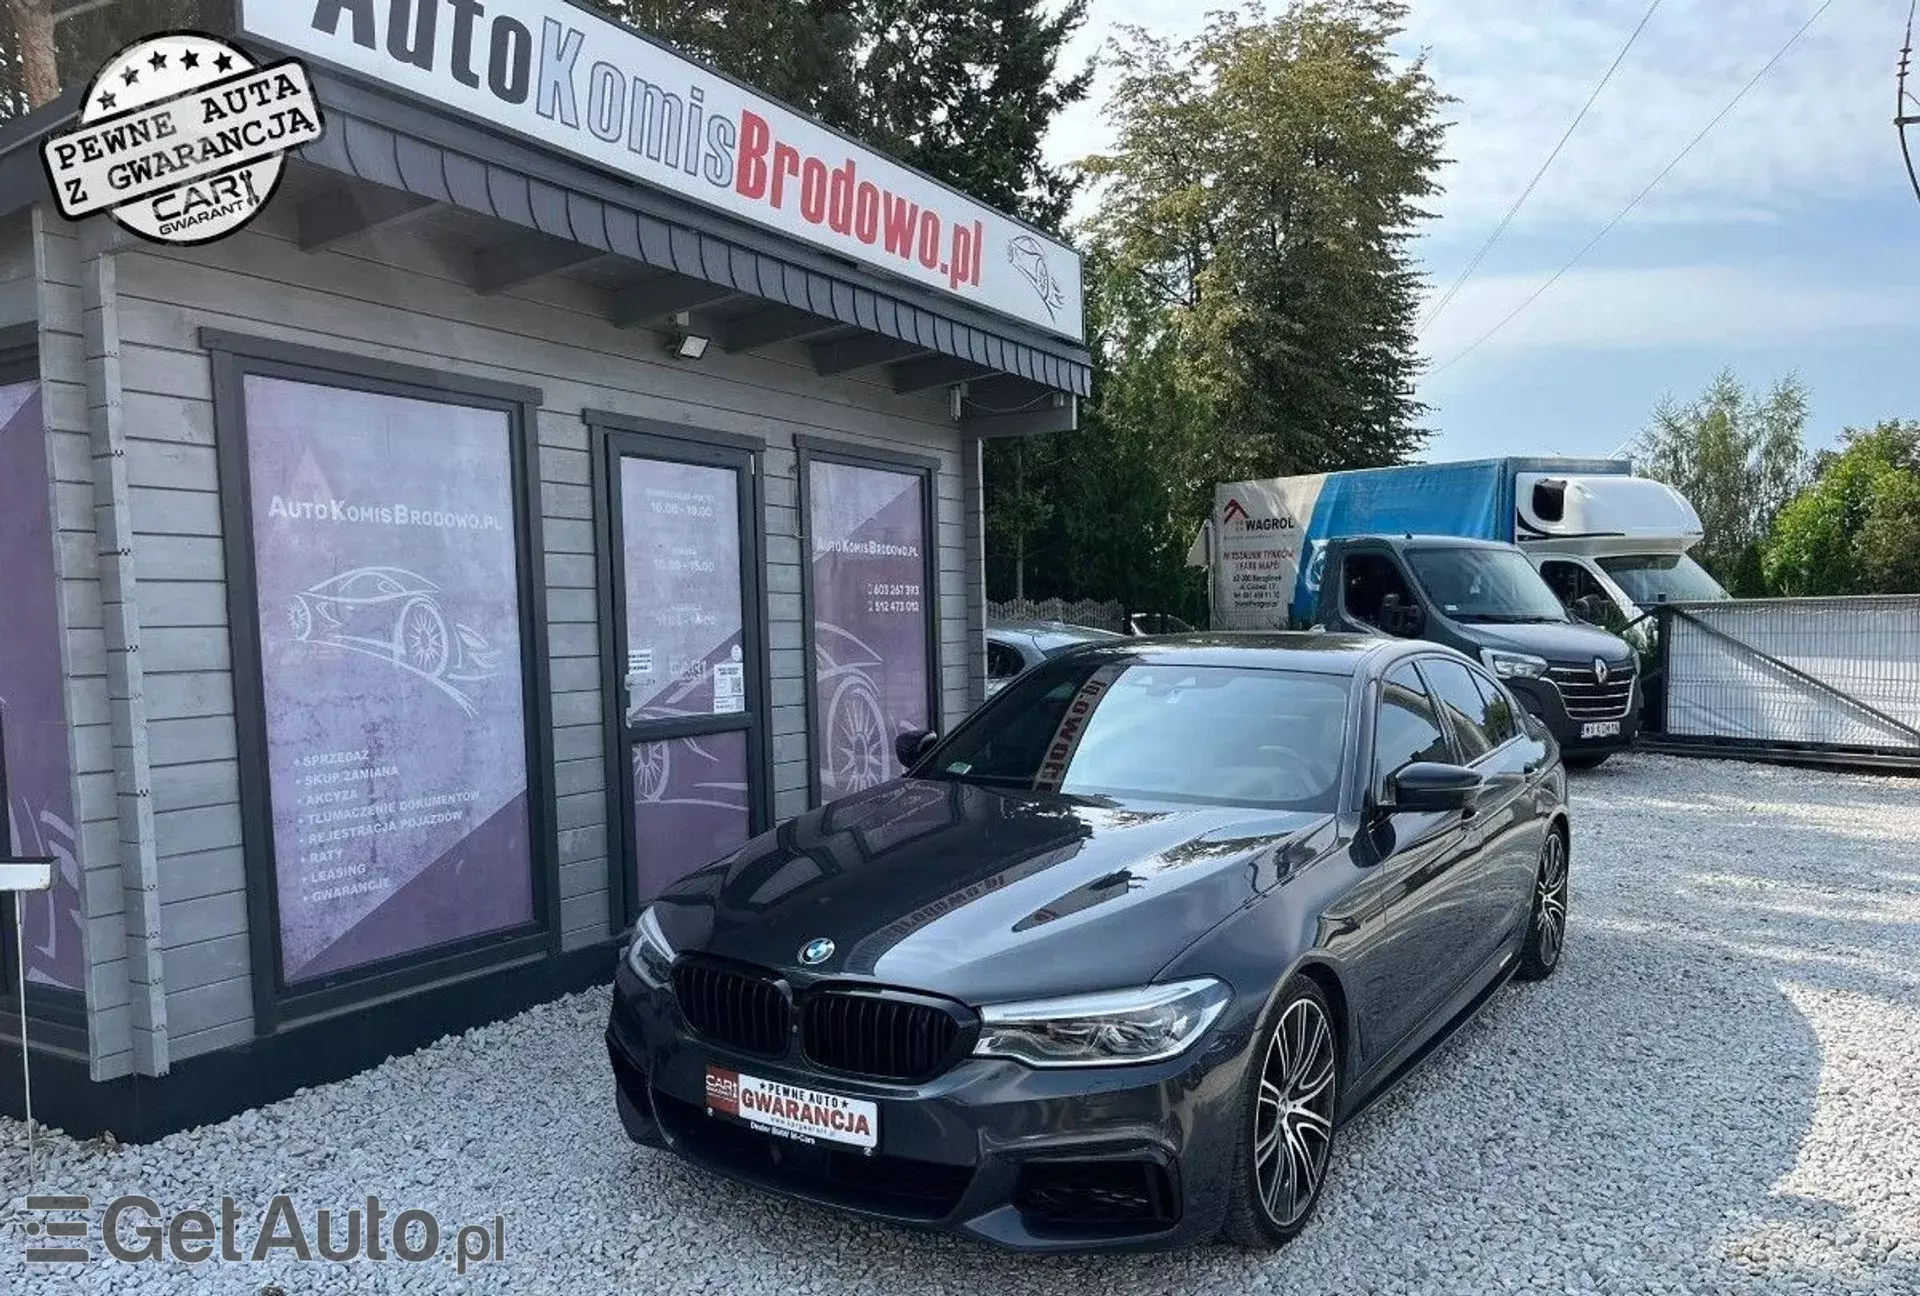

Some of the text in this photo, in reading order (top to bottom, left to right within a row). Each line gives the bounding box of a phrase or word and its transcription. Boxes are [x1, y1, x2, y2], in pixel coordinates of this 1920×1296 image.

[1245, 517, 1295, 531] WAGROL
[305, 772, 340, 786] SKUP
[306, 790, 358, 806] AKCYZA
[309, 821, 397, 844] REJESTRACJA
[310, 849, 343, 863] RATY
[311, 864, 367, 883] LEASING
[768, 1083, 838, 1107] PEWNE AUTO
[741, 1088, 870, 1136] GWARANCJA
